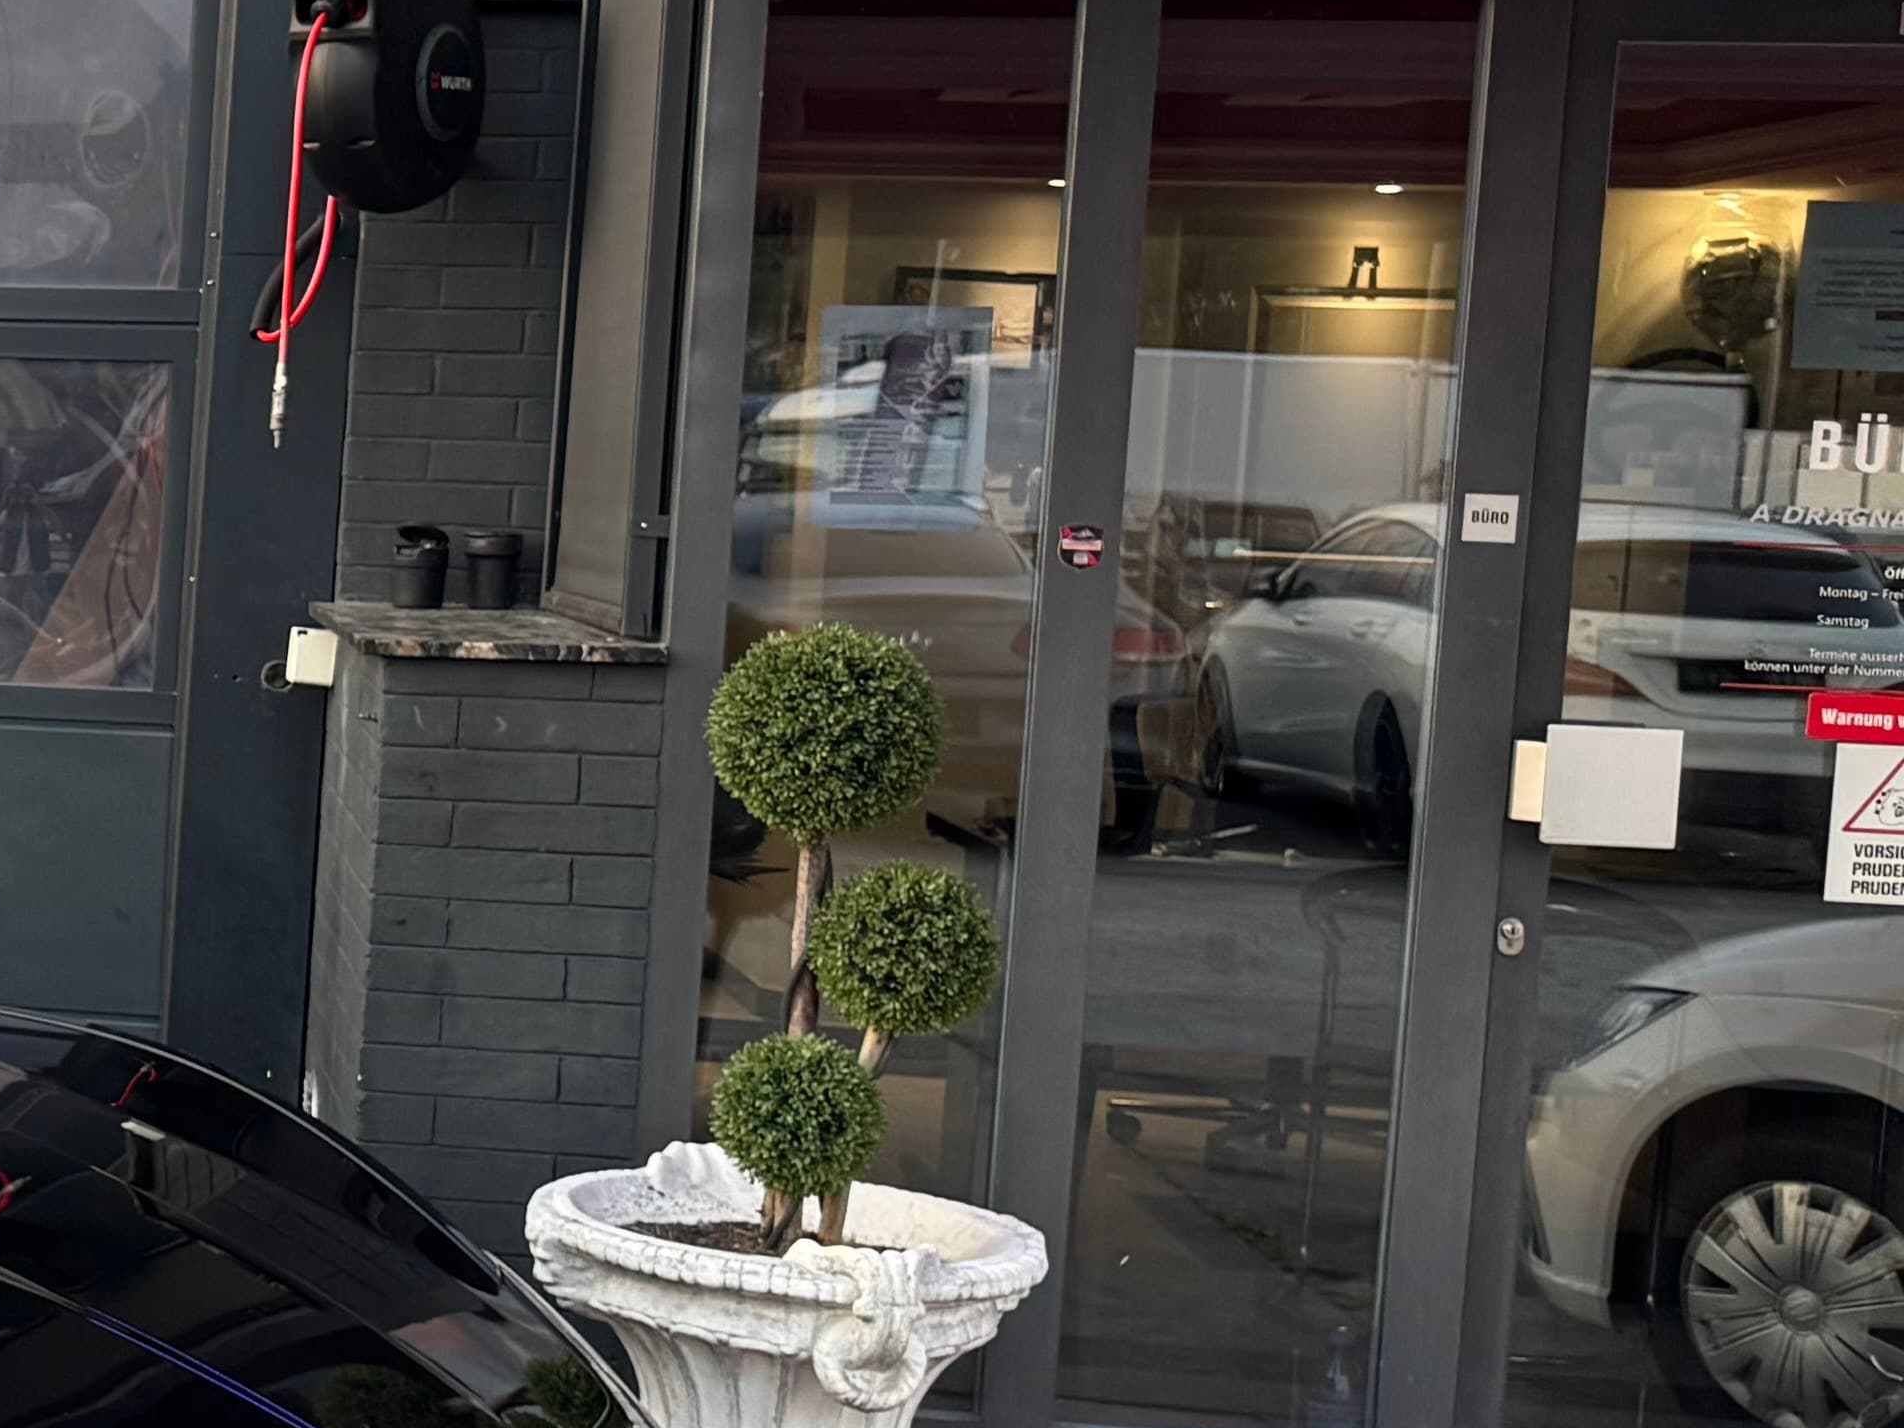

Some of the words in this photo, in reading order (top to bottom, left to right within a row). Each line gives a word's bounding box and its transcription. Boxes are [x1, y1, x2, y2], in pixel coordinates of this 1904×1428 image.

[1809, 413, 1904, 473] BÜ
[1472, 508, 1509, 525] BÜRO
[1819, 586, 1868, 601] Montag
[1817, 614, 1869, 629] Samstag
[1809, 648, 1857, 661] Termine
[1793, 663, 1826, 674] unter
[1829, 664, 1850, 674] der
[1821, 708, 1893, 730] Warnung
[1852, 862, 1904, 878] PRUDE
